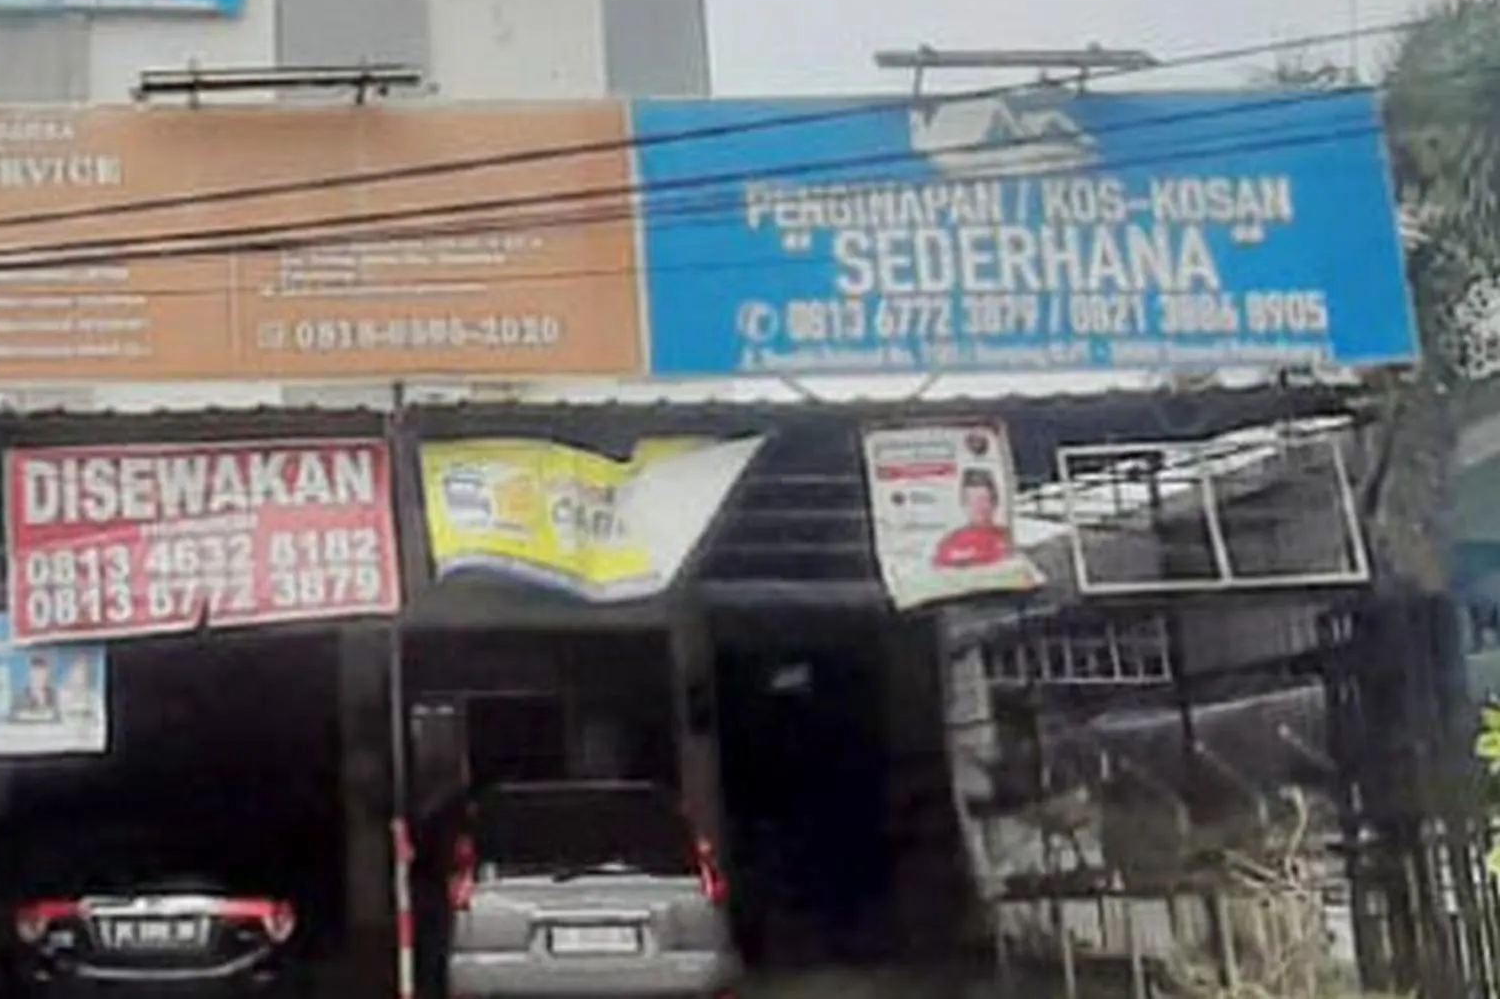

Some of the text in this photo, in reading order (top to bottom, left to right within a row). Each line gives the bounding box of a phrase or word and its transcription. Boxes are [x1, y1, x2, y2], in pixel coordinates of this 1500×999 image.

[1041, 174, 1293, 224] KOS-KOSAN
[833, 223, 1221, 295] SEDERHANA
[23, 449, 374, 525] DISEWAKAN
[27, 544, 131, 587] 0813
[143, 534, 255, 576] 4632
[27, 585, 134, 629] 0813
